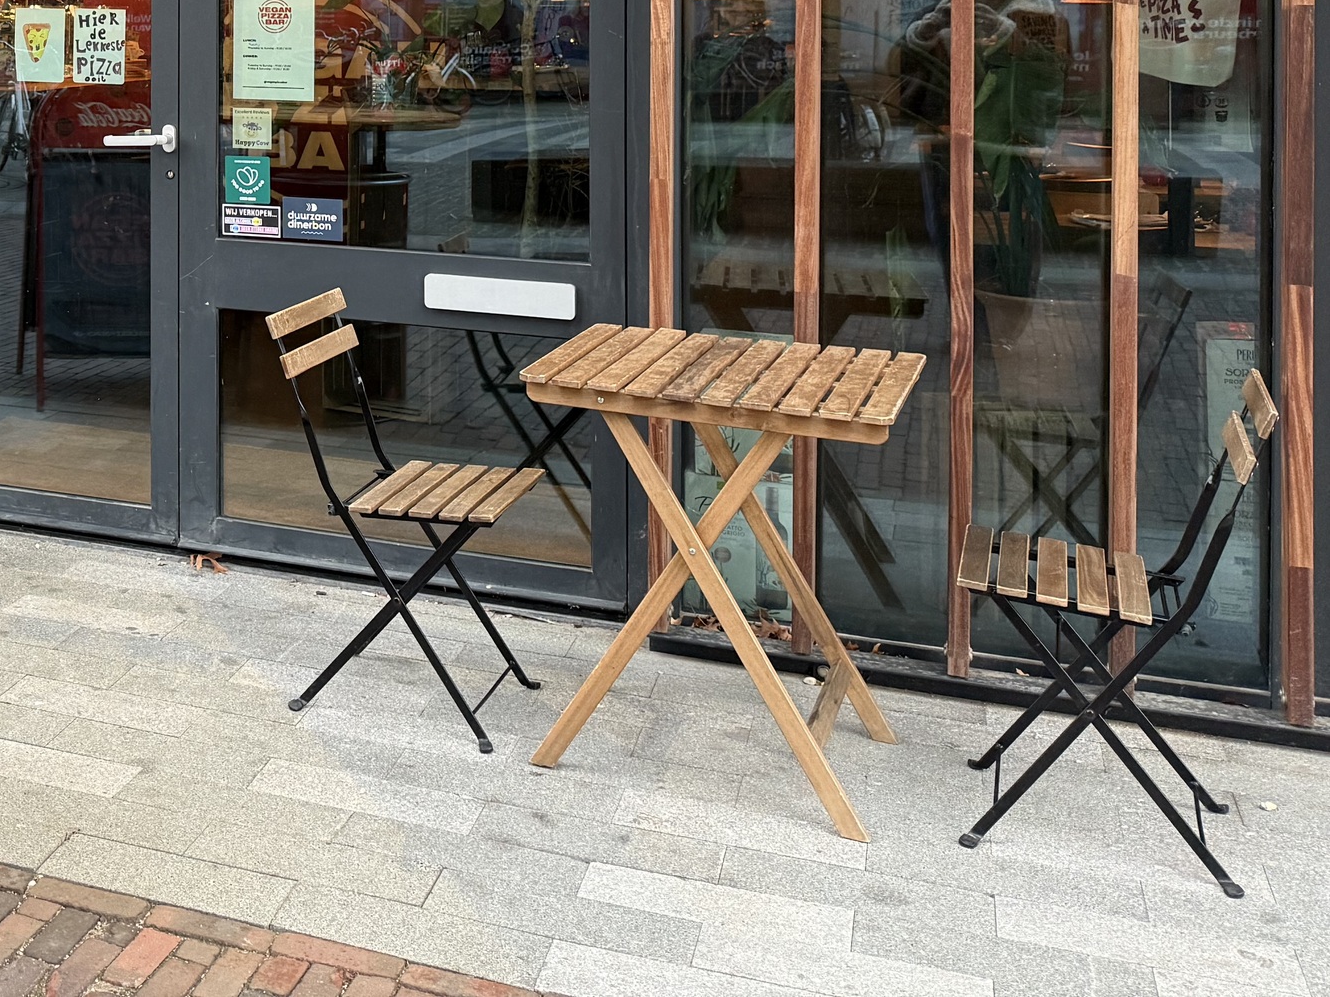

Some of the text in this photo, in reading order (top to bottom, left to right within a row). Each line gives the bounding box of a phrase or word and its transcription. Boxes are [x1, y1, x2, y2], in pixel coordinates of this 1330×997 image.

[90, 28, 106, 40] de
[225, 207, 238, 215] WIJ
[287, 211, 337, 222] duurzame
[287, 218, 332, 230] dinerbon
